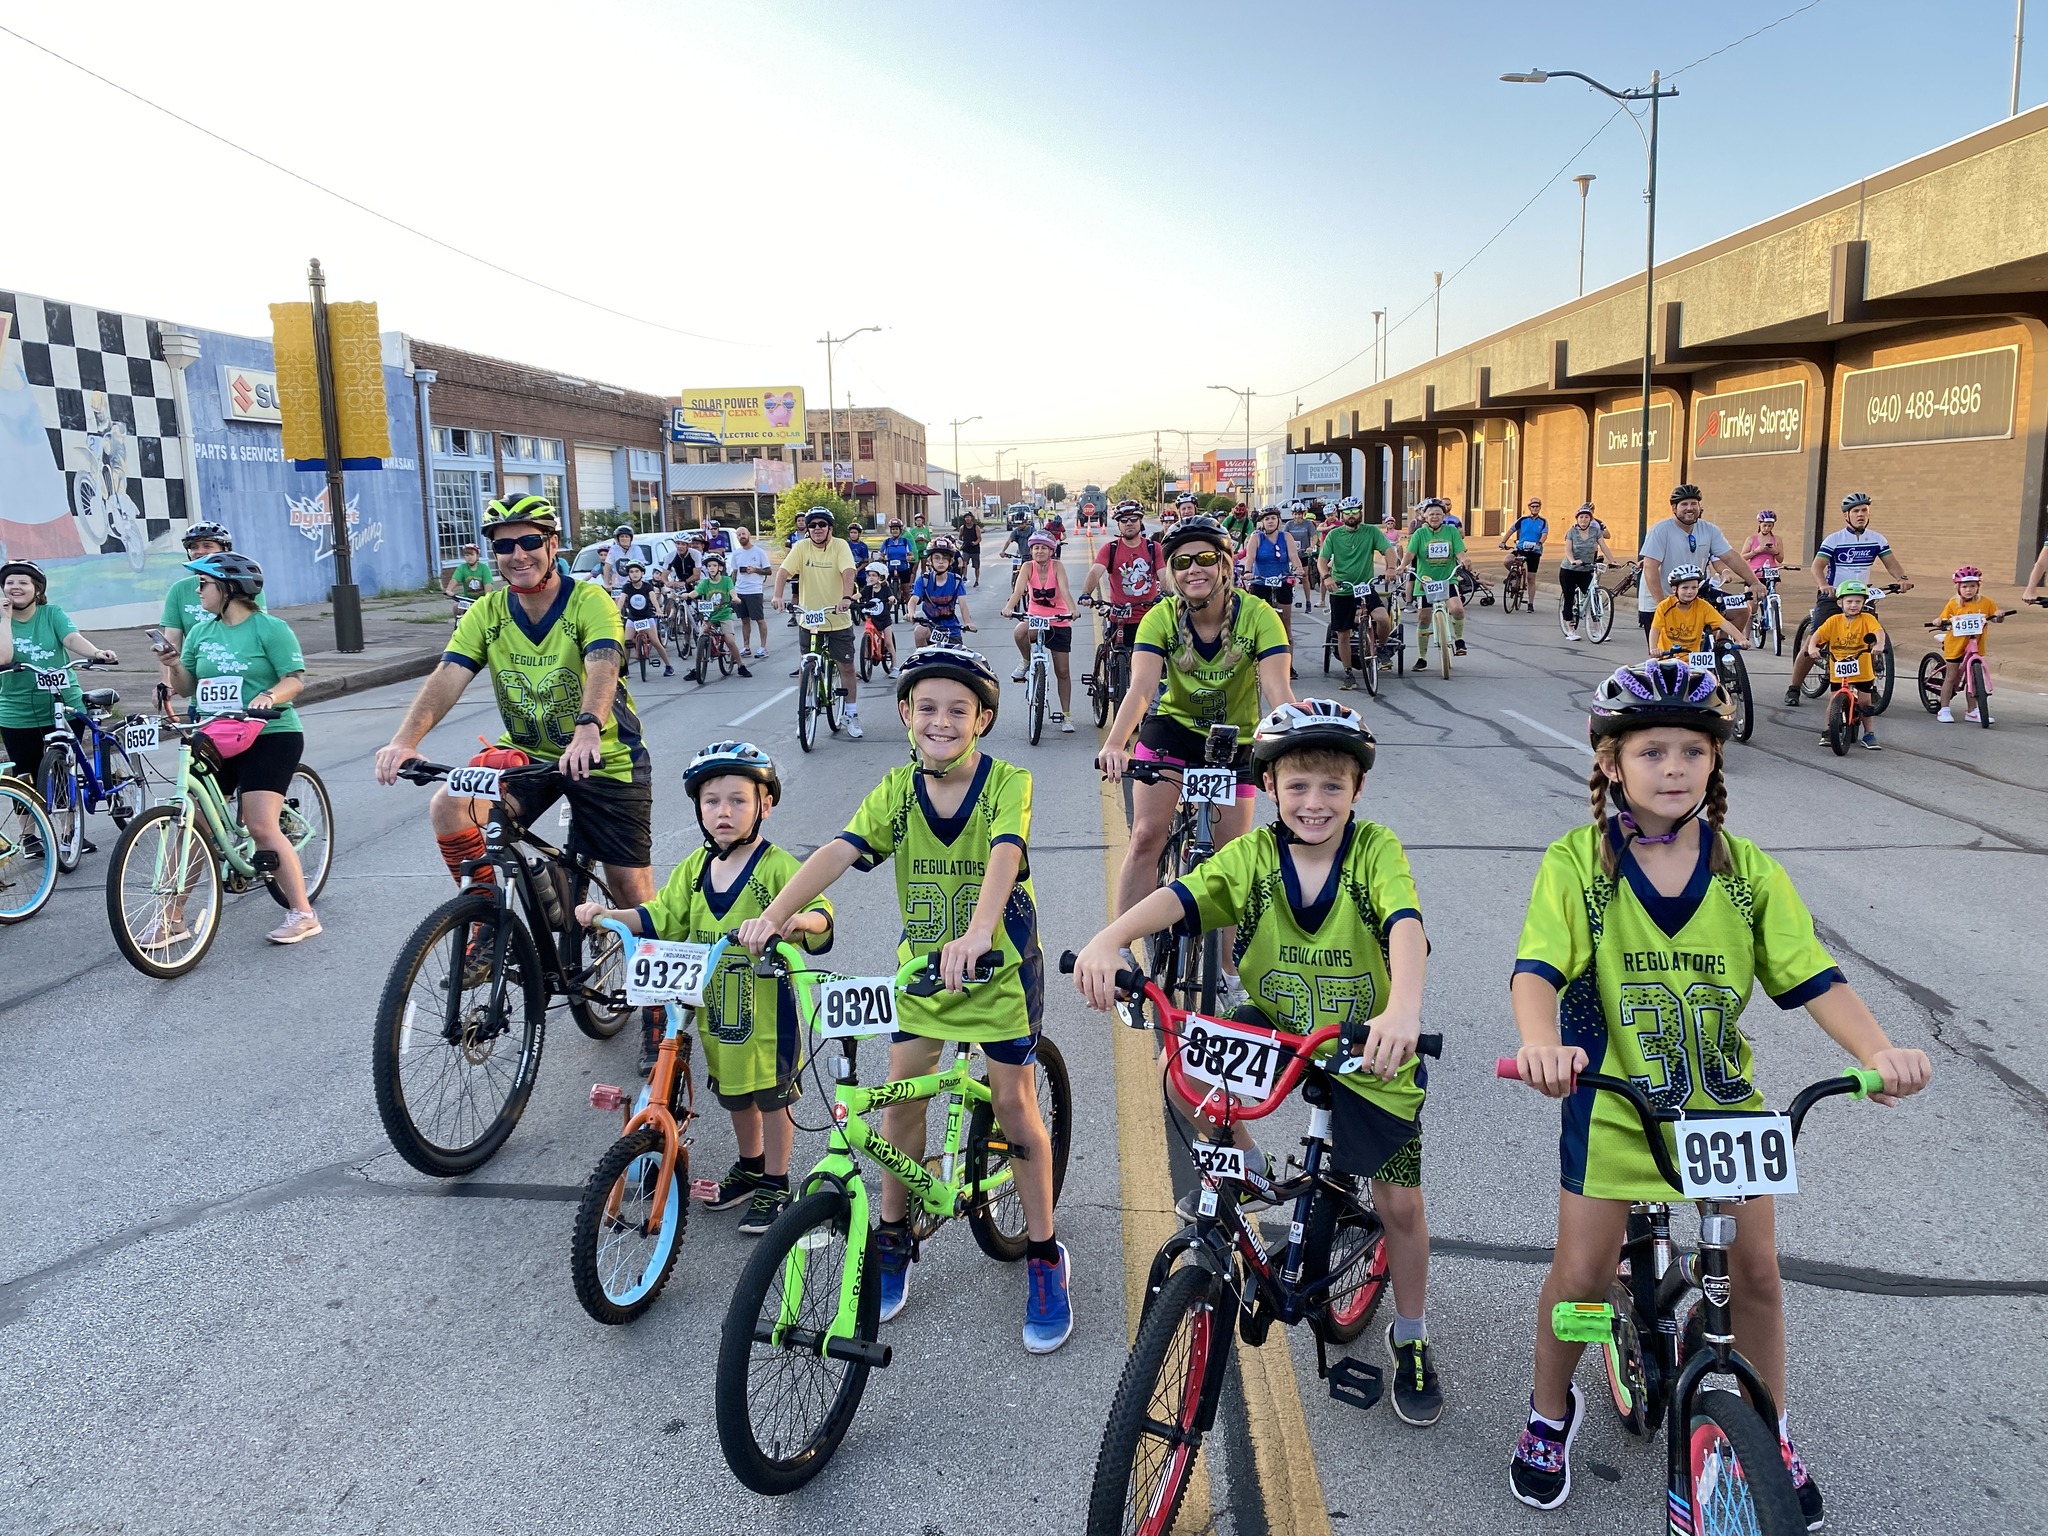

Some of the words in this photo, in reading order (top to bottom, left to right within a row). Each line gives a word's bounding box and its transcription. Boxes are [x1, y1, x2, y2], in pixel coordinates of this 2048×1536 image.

[692, 398, 721, 410] SOLAR
[724, 397, 759, 409] POWER
[693, 409, 721, 418] MAKE
[728, 409, 760, 417] CENTS.
[1867, 394, 1902, 425] (940)
[1905, 383, 1982, 420] 488-4896
[1719, 408, 1756, 443] TurnKey
[1759, 405, 1799, 440] Storage
[1608, 431, 1628, 450] Drive
[1631, 428, 1657, 448] Indor
[195, 443, 227, 460] PARTS
[230, 446, 238, 460] &
[240, 446, 279, 462] SERVICE
[1427, 584, 1443, 592] 9234
[805, 612, 824, 625] 9286
[1955, 620, 1980, 630] 4955
[1690, 654, 1713, 666] 4902
[1836, 663, 1858, 674] 4903
[201, 685, 238, 702] 6592
[127, 728, 156, 749] 6592
[450, 770, 497, 795] 9322
[913, 859, 985, 877] REGULATORS
[1279, 944, 1353, 967] REGULATORS
[1624, 951, 1726, 975] REGULATORS
[634, 958, 703, 990] 9323
[827, 984, 893, 1029] 9320
[532, 1023, 542, 1059] GIANT
[1620, 982, 1755, 1109] 30
[1187, 1026, 1271, 1088] 9324
[1684, 1129, 1789, 1185] 9319
[1234, 1201, 1268, 1266] SCHWINN
[852, 1246, 865, 1296] Razor
